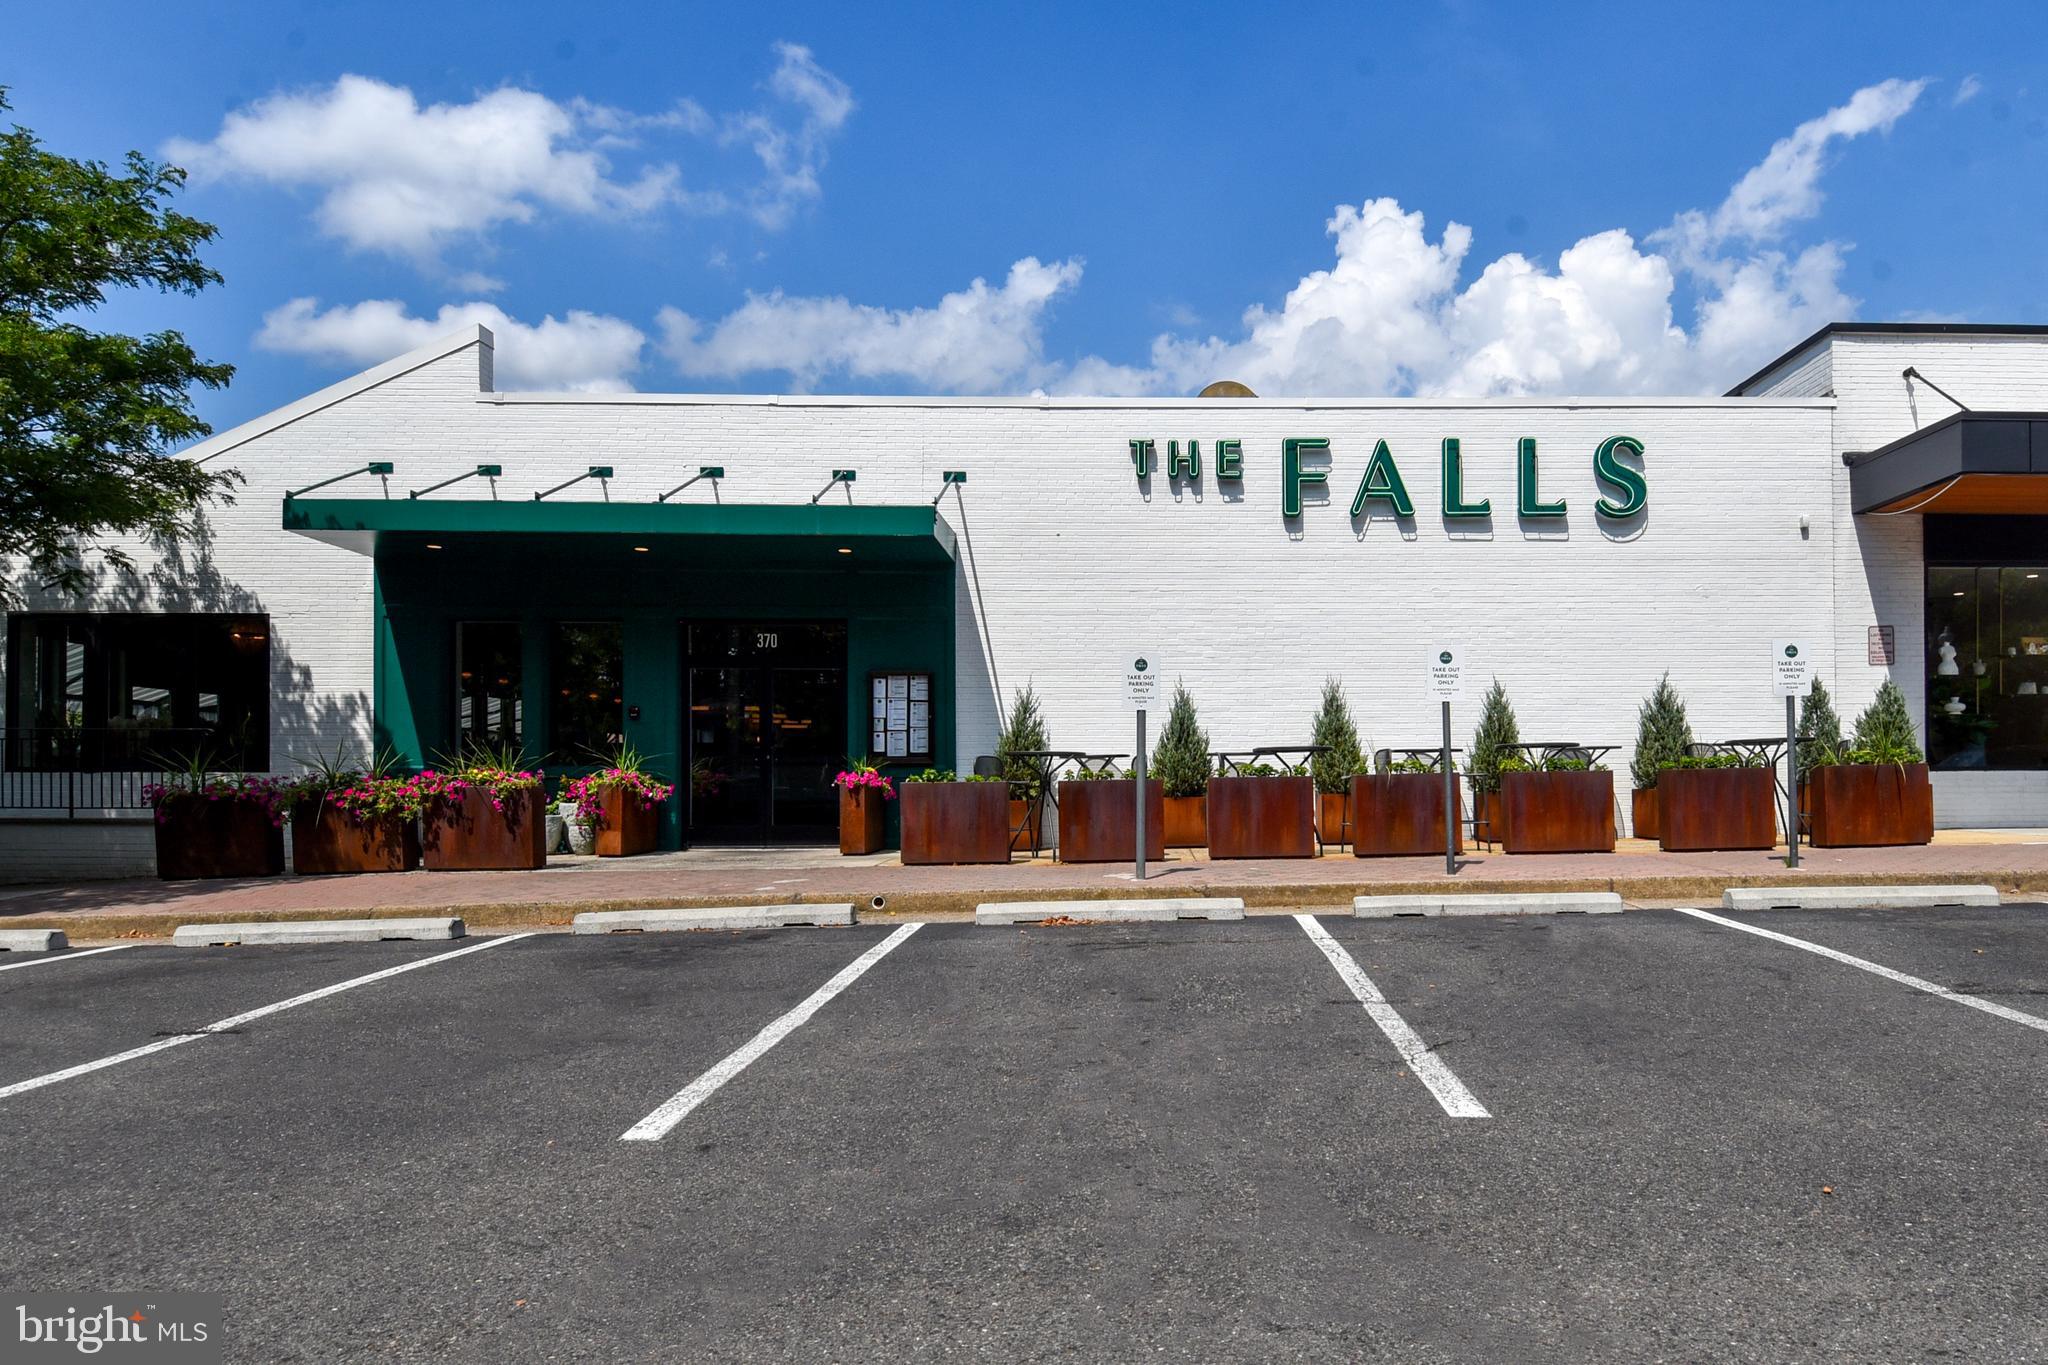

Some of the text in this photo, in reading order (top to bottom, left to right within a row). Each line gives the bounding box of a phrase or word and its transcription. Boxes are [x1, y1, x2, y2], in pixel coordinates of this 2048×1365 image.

[1128, 435, 1648, 519] THE FALLS
[756, 633, 778, 649] 370
